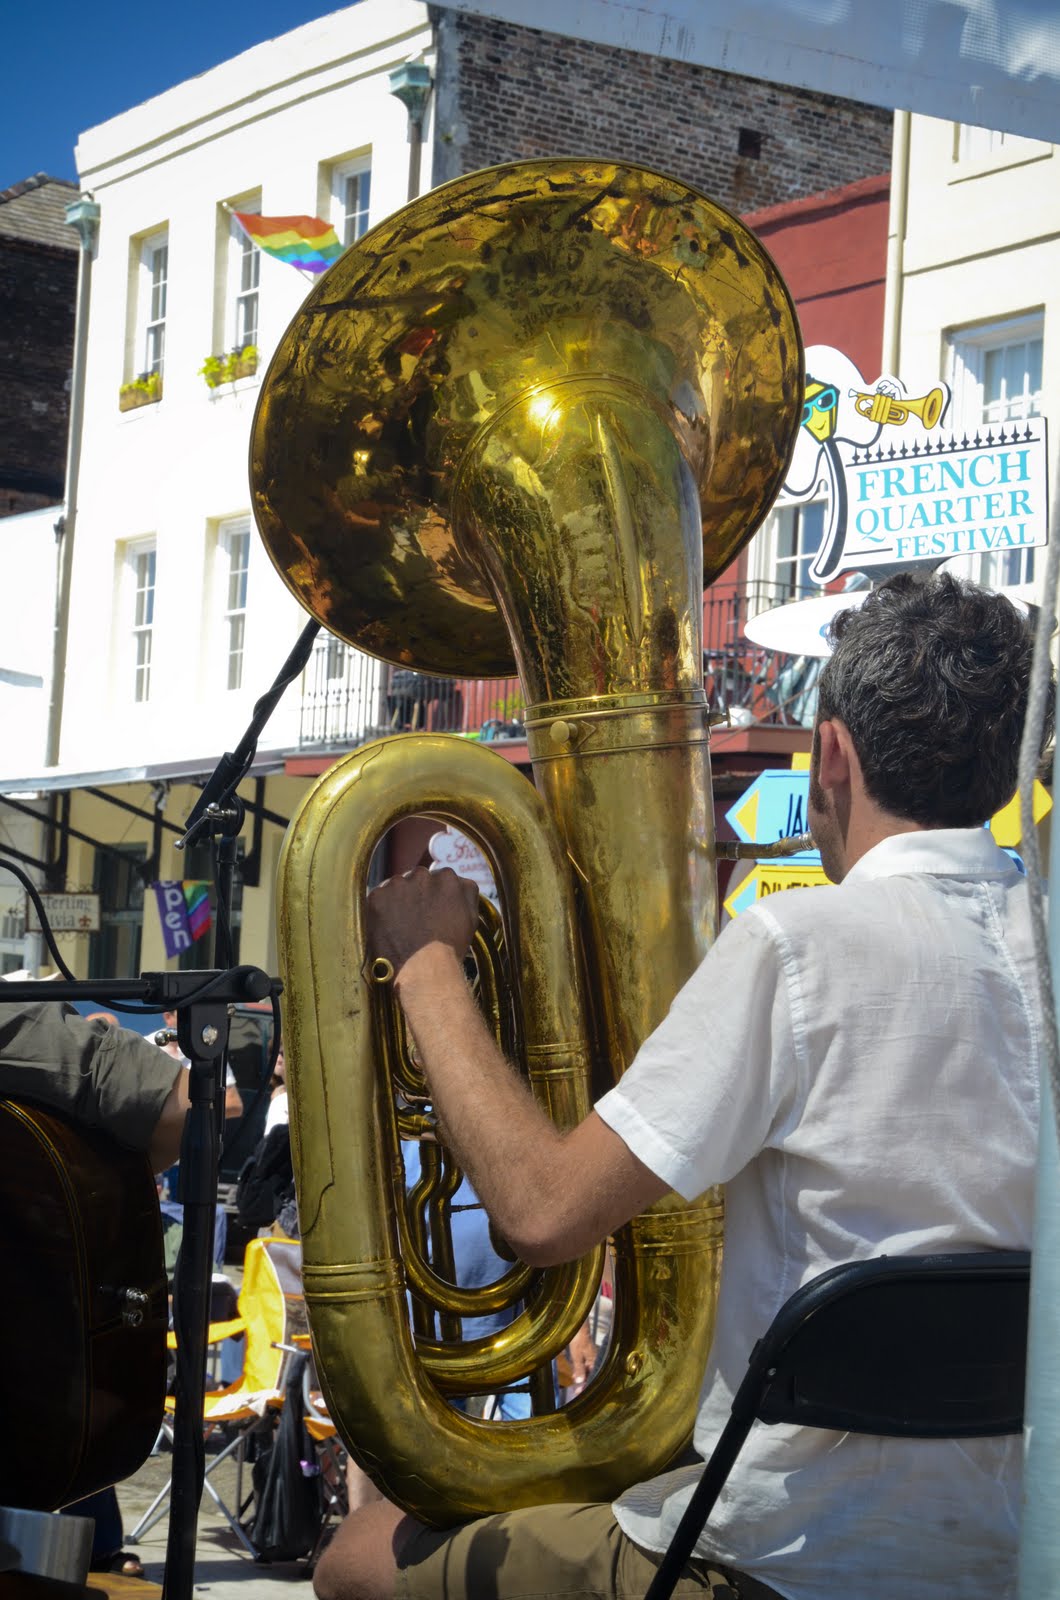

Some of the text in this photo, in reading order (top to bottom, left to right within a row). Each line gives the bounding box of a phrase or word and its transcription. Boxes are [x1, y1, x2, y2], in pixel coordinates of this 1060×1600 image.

[856, 450, 1031, 502] FRENCH
[855, 489, 1034, 543] QUARTER
[896, 523, 1035, 558] FESTIVAL
[40, 895, 92, 912] terling
